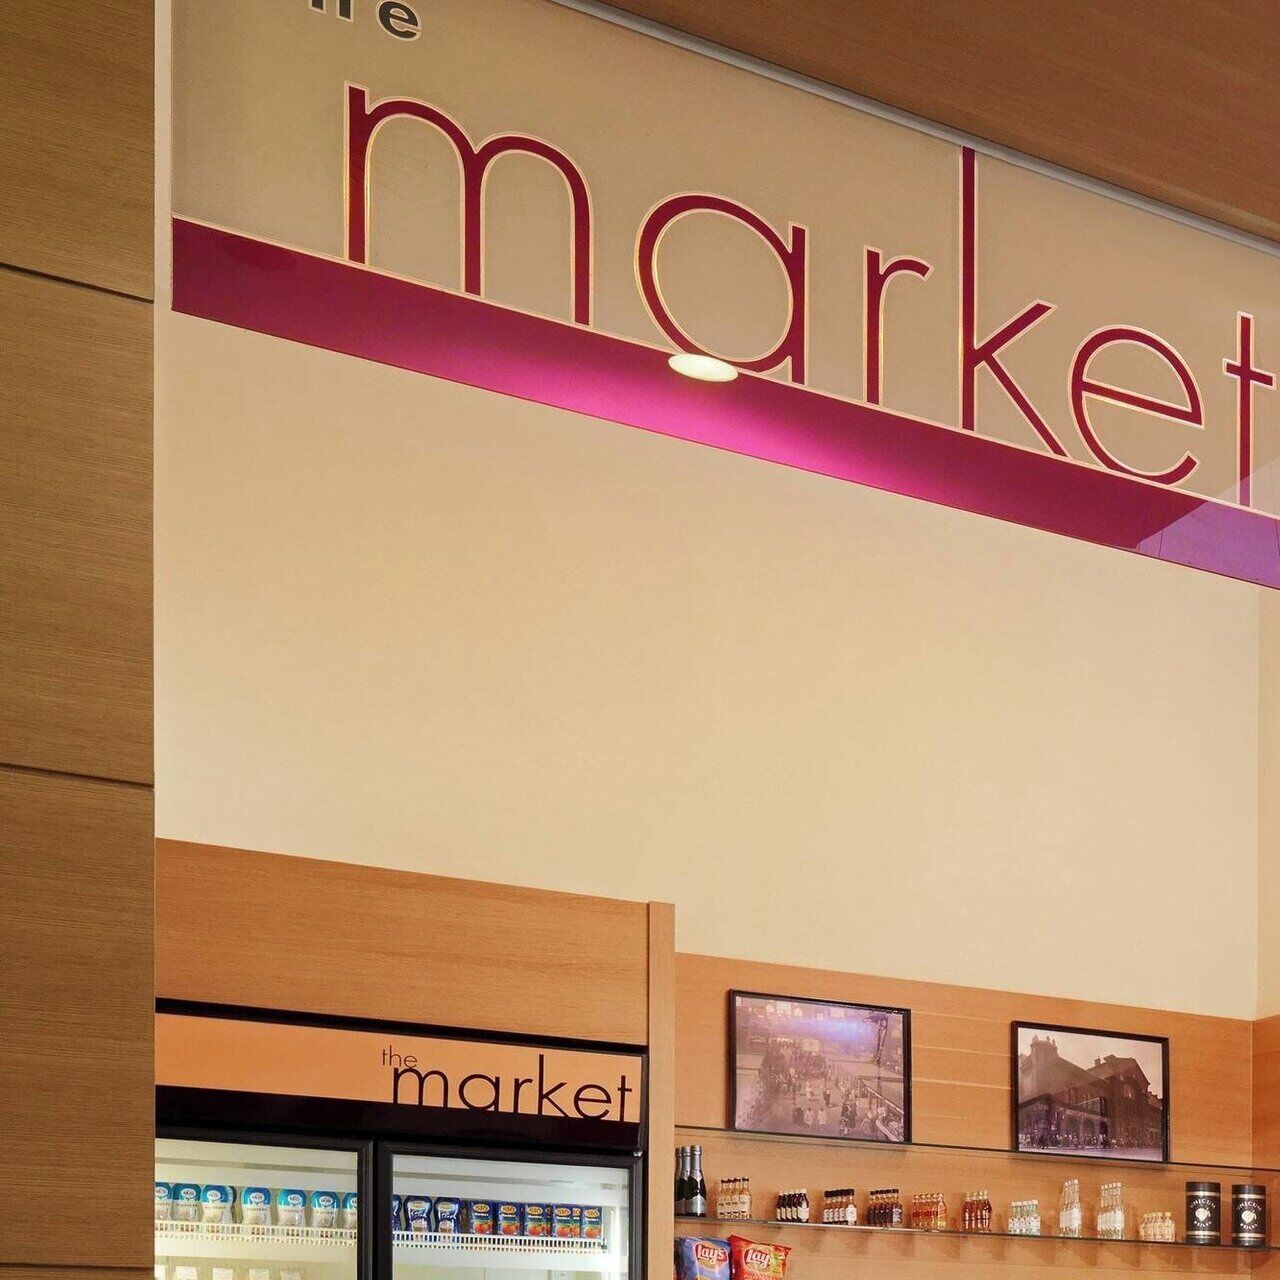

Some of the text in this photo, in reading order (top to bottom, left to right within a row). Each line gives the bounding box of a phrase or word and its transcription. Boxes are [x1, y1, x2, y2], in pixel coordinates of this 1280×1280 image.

[346, 83, 1275, 507] market
[382, 1045, 418, 1068] the
[393, 1054, 633, 1122] market
